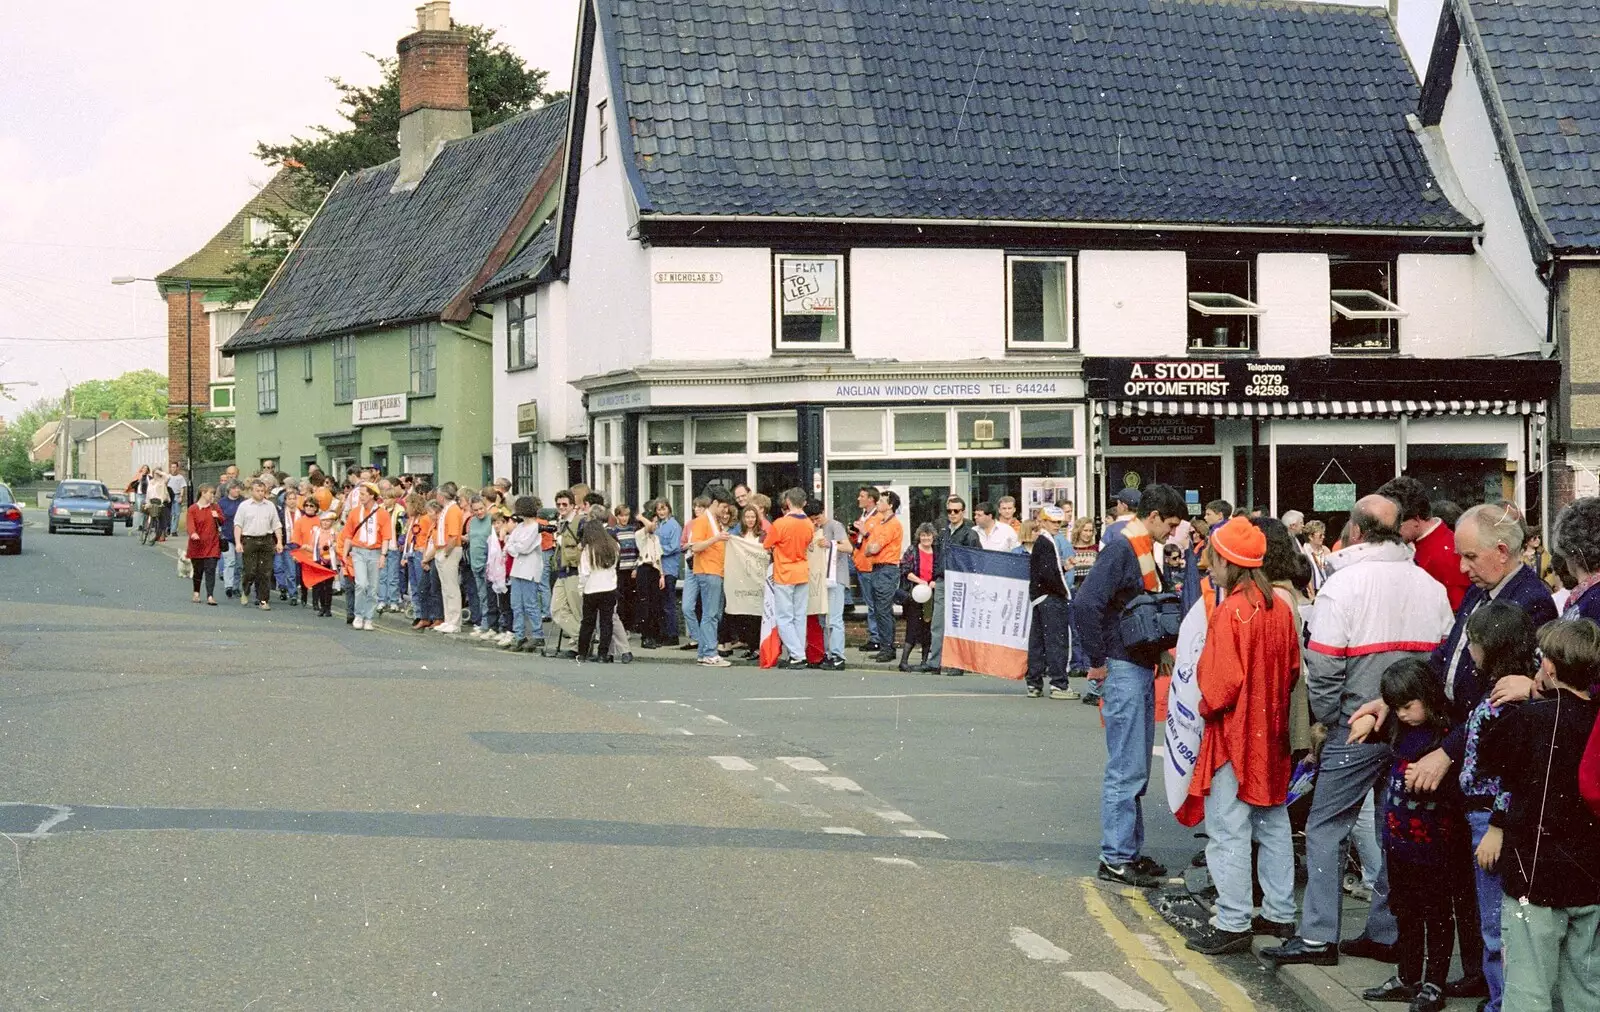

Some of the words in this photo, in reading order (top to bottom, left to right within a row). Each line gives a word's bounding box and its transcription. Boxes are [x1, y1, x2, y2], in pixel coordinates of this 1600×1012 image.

[795, 262, 824, 273] FLAT
[669, 273, 706, 282] NICHOLAS
[790, 276, 806, 288] TO
[791, 283, 812, 298] LET
[1130, 363, 1149, 379] A.
[1154, 363, 1226, 380] STODEL
[1246, 362, 1286, 373] Telephone
[1252, 374, 1282, 386] 0379
[836, 385, 880, 396] ANGLIAN
[885, 385, 928, 396] WINDOW
[933, 384, 981, 395] CENTRES
[989, 384, 1011, 394] TEL:
[1016, 383, 1057, 394] 644244
[1124, 381, 1230, 396] OPTOMETRIST
[1245, 385, 1290, 397] 642598
[1118, 425, 1205, 435] OPTOMETRIST
[1166, 710, 1179, 741] MBLEY
[1176, 741, 1198, 766] 1994
